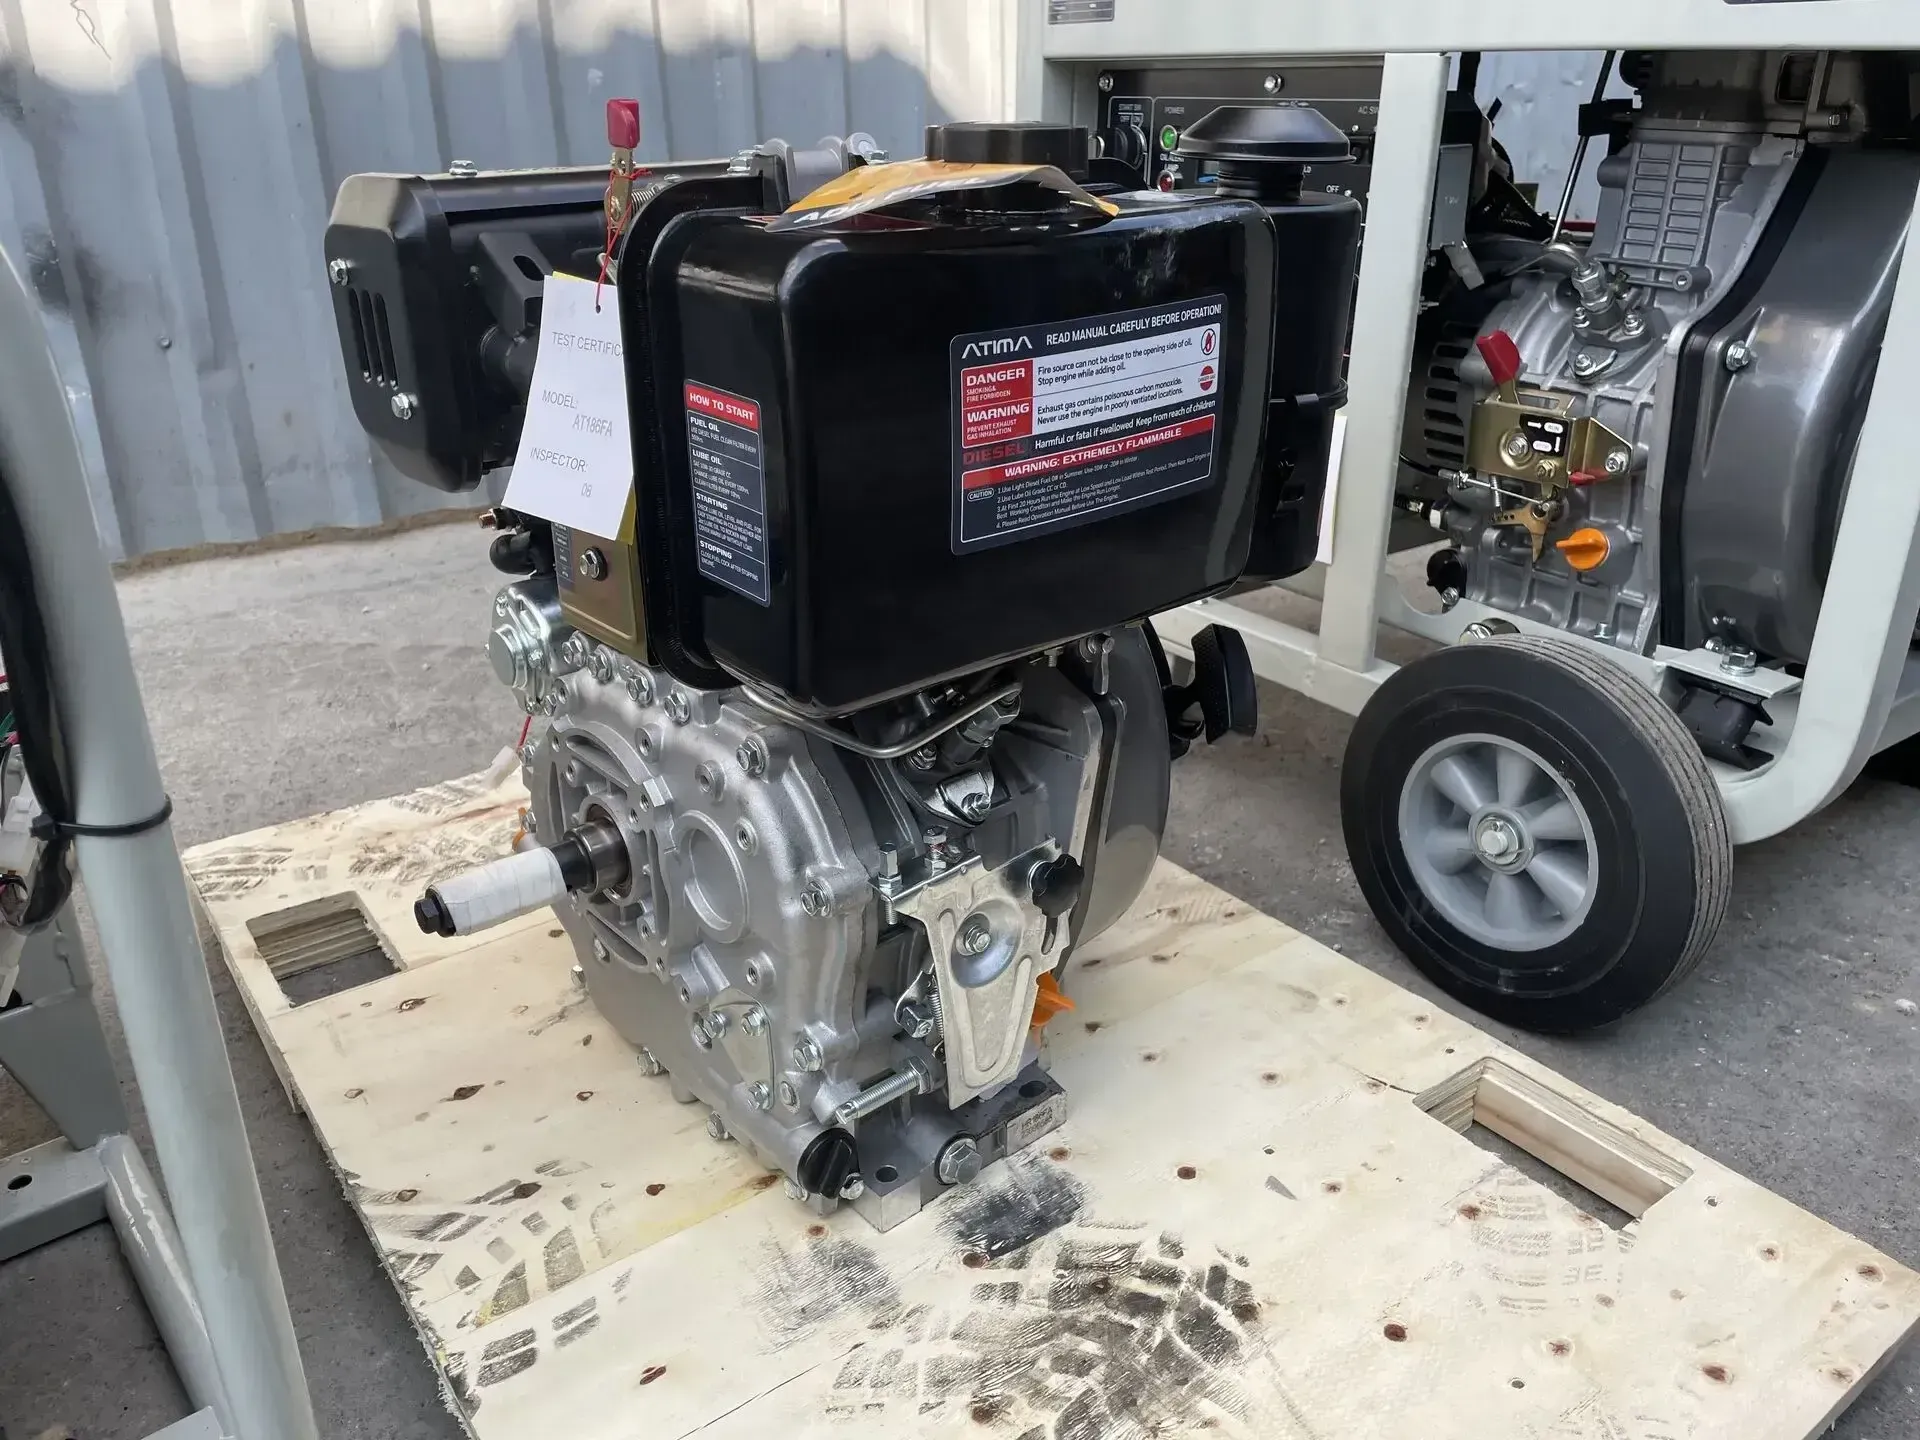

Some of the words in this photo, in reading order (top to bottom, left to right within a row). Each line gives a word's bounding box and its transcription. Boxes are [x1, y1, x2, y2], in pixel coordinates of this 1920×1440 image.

[1165, 106, 1184, 114] POWER
[1326, 185, 1339, 193] OFF
[1046, 332, 1070, 344] READ
[1072, 326, 1108, 340] MANUAL
[1110, 318, 1149, 334] CAREFULY
[1151, 312, 1179, 326] BEFORE
[1181, 304, 1221, 320] OPERATION!
[552, 332, 576, 348] TEST
[962, 336, 1031, 358] ATIMA
[1038, 366, 1051, 374] Fire
[1052, 363, 1074, 372] source
[1088, 357, 1098, 365] not
[1108, 353, 1124, 362] close
[1132, 349, 1142, 357] the
[1143, 345, 1165, 356] opening
[1166, 342, 1177, 350] side
[1178, 339, 1184, 347] of
[1184, 338, 1192, 346] oil.
[966, 368, 1024, 385] DANGER
[1038, 377, 1053, 385] Stop
[1054, 373, 1076, 383] engine
[1077, 368, 1094, 378] while
[1095, 365, 1115, 374] adding
[1116, 361, 1125, 370] oil.
[542, 390, 579, 409] MODEL:
[980, 390, 1010, 400] FORBIDDEN
[1037, 403, 1063, 414] Exhaust
[1064, 402, 1075, 411] gas
[1077, 396, 1103, 406] contains
[1104, 389, 1133, 402] poisonous
[1134, 385, 1154, 394] carbon
[1155, 378, 1182, 389] monoxide.
[690, 393, 709, 405] HOW
[712, 399, 723, 410] TO
[726, 404, 753, 420] START
[967, 403, 1028, 421] WARNING
[1037, 416, 1056, 424] Never
[1070, 410, 1081, 418] the
[1082, 406, 1102, 416] engine
[1104, 403, 1109, 411] in
[1110, 399, 1129, 411] poorly
[1158, 388, 1182, 398] locations.
[572, 414, 612, 437] AT186FA
[690, 416, 706, 427] FUEL
[708, 422, 719, 432] OIL
[967, 423, 991, 432] PREVENT
[992, 419, 1016, 428] EXHAUST
[979, 427, 1011, 437] INHALATION
[1035, 434, 1064, 448] Harmful
[1076, 429, 1091, 440] fatal
[1093, 427, 1098, 436] if
[1100, 419, 1133, 434] swallowed
[1136, 417, 1151, 426] Keep
[1153, 413, 1167, 421] from
[1168, 406, 1185, 417] reach
[1186, 404, 1192, 413] of
[1193, 400, 1215, 411] children
[530, 447, 587, 473] INSPECTOR:
[692, 449, 709, 460] LUBE
[710, 456, 721, 465] OIL
[962, 439, 1025, 465] DIESEL
[1005, 458, 1059, 476] WARNING:
[1063, 443, 1123, 463] EXTREMELY
[1126, 428, 1180, 448] FLAMMABLE
[696, 493, 727, 509] STARTING
[969, 488, 992, 500] CAUTION
[700, 540, 731, 558] STOPPING
